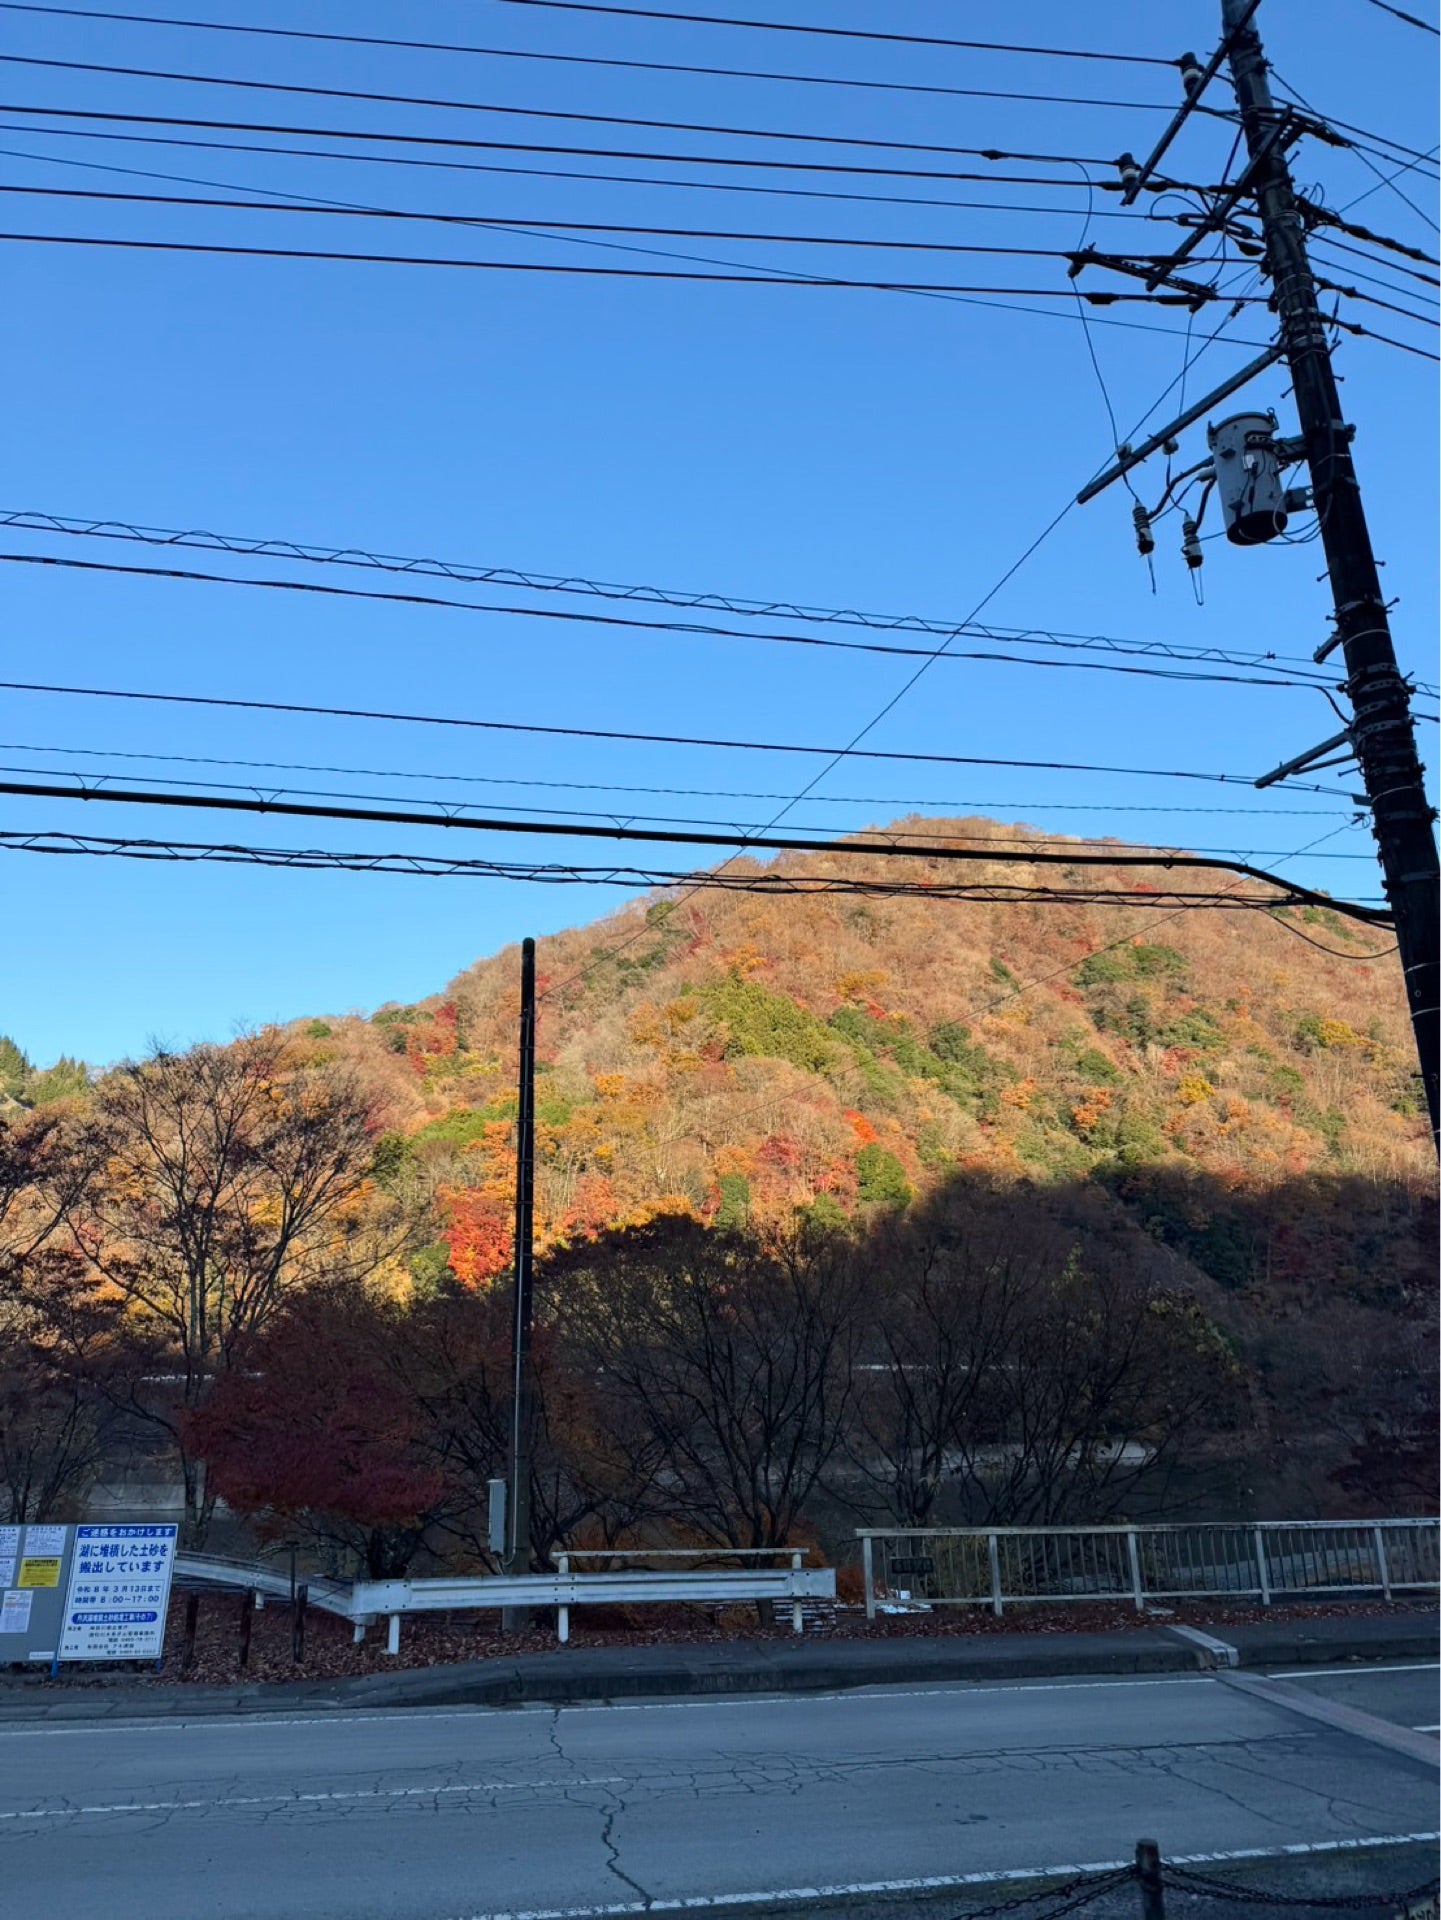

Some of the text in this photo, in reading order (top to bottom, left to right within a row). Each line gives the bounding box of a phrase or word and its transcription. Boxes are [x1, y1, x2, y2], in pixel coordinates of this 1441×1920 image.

[82, 1528, 174, 1538] ご迷惑をおかけします
[79, 1544, 168, 1558] 湖に堆積した土砂を
[79, 1561, 164, 1574] 搬出しています
